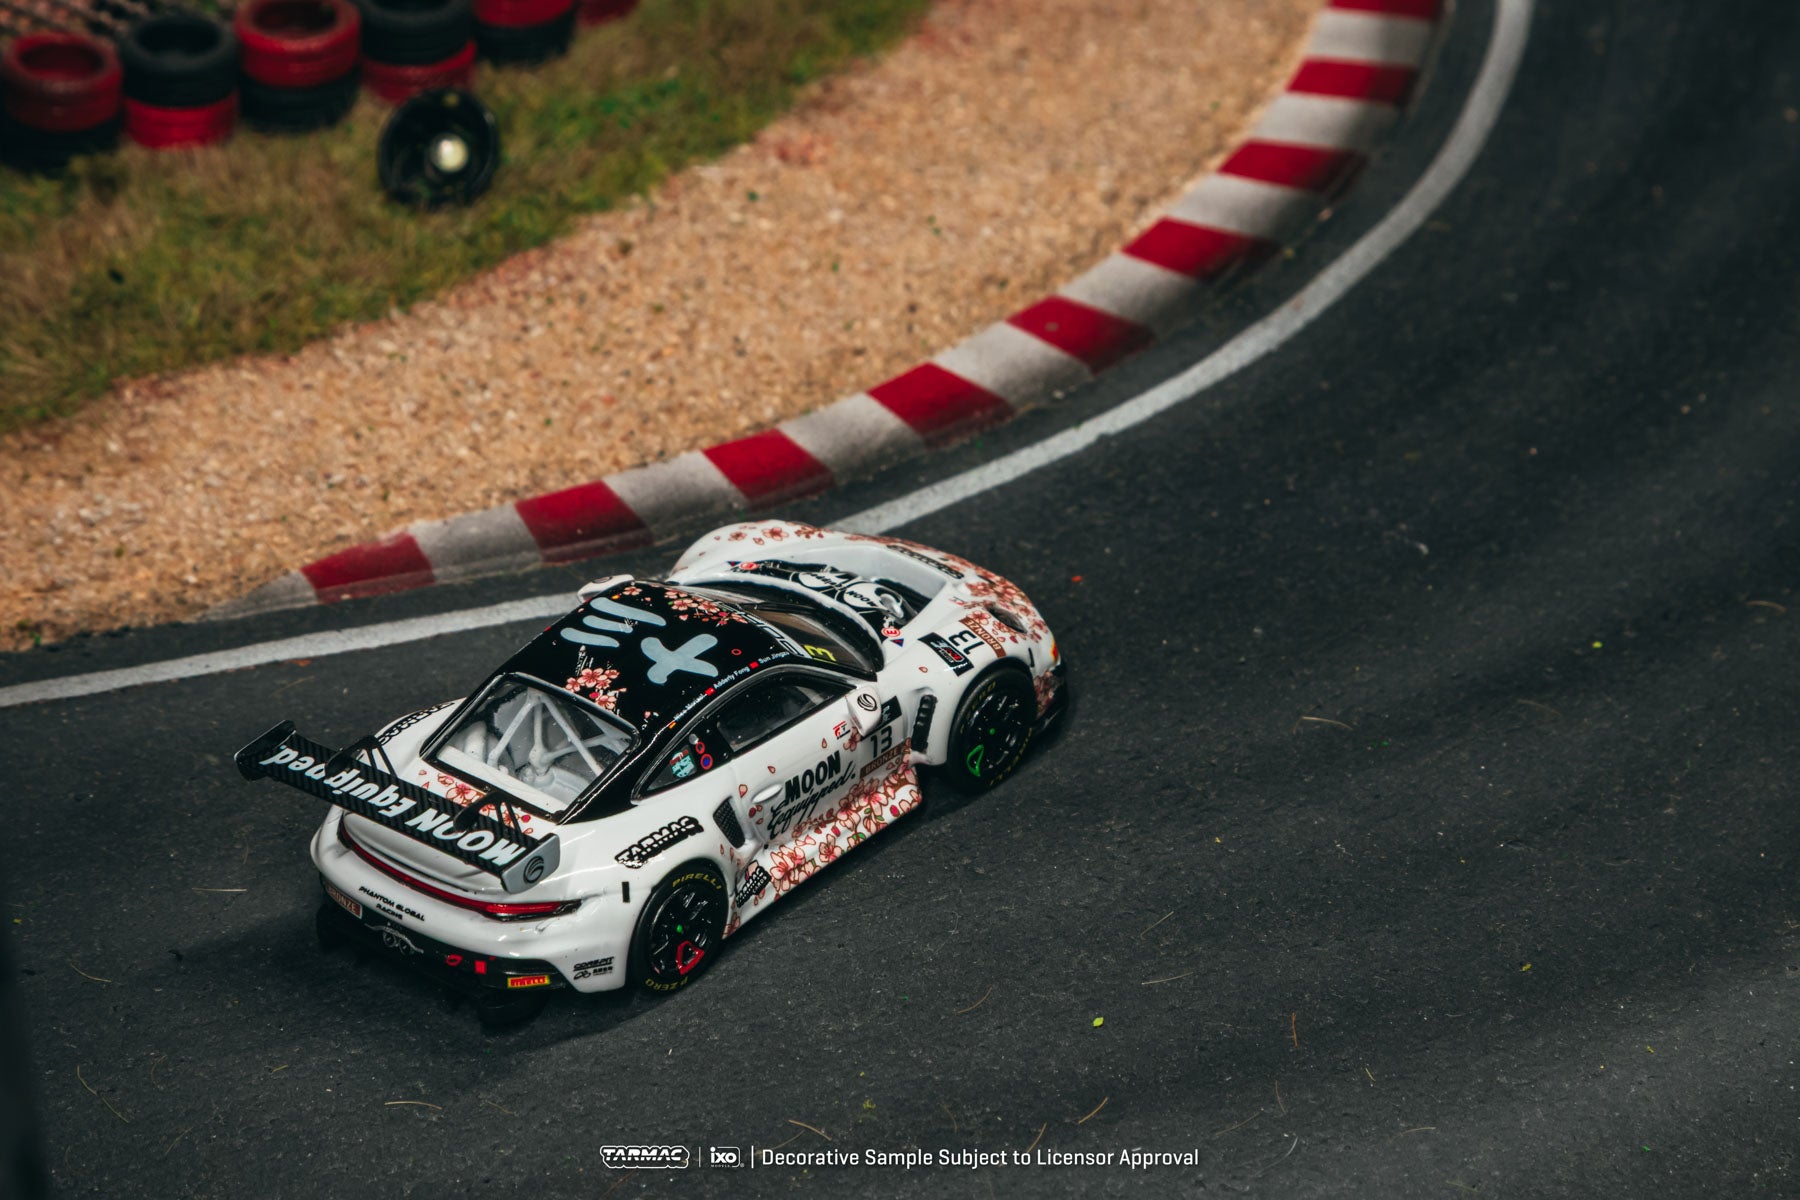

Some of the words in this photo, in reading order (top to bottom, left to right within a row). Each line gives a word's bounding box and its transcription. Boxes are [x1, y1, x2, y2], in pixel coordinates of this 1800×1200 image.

[948, 629, 986, 656] 13
[965, 619, 1002, 651] BRONZE
[713, 674, 736, 689] Adderly
[733, 665, 751, 677] Fong
[870, 725, 893, 759] 13
[864, 747, 899, 774] BRONZE
[785, 750, 841, 804] MOON
[405, 808, 526, 867] MOON
[615, 815, 704, 867] TARMAC
[672, 872, 723, 890] PIRELLI
[358, 886, 395, 908] PHANTOM
[396, 904, 425, 922] GLOBAL
[375, 903, 403, 921] RACING
[645, 977, 680, 992] ZERO
